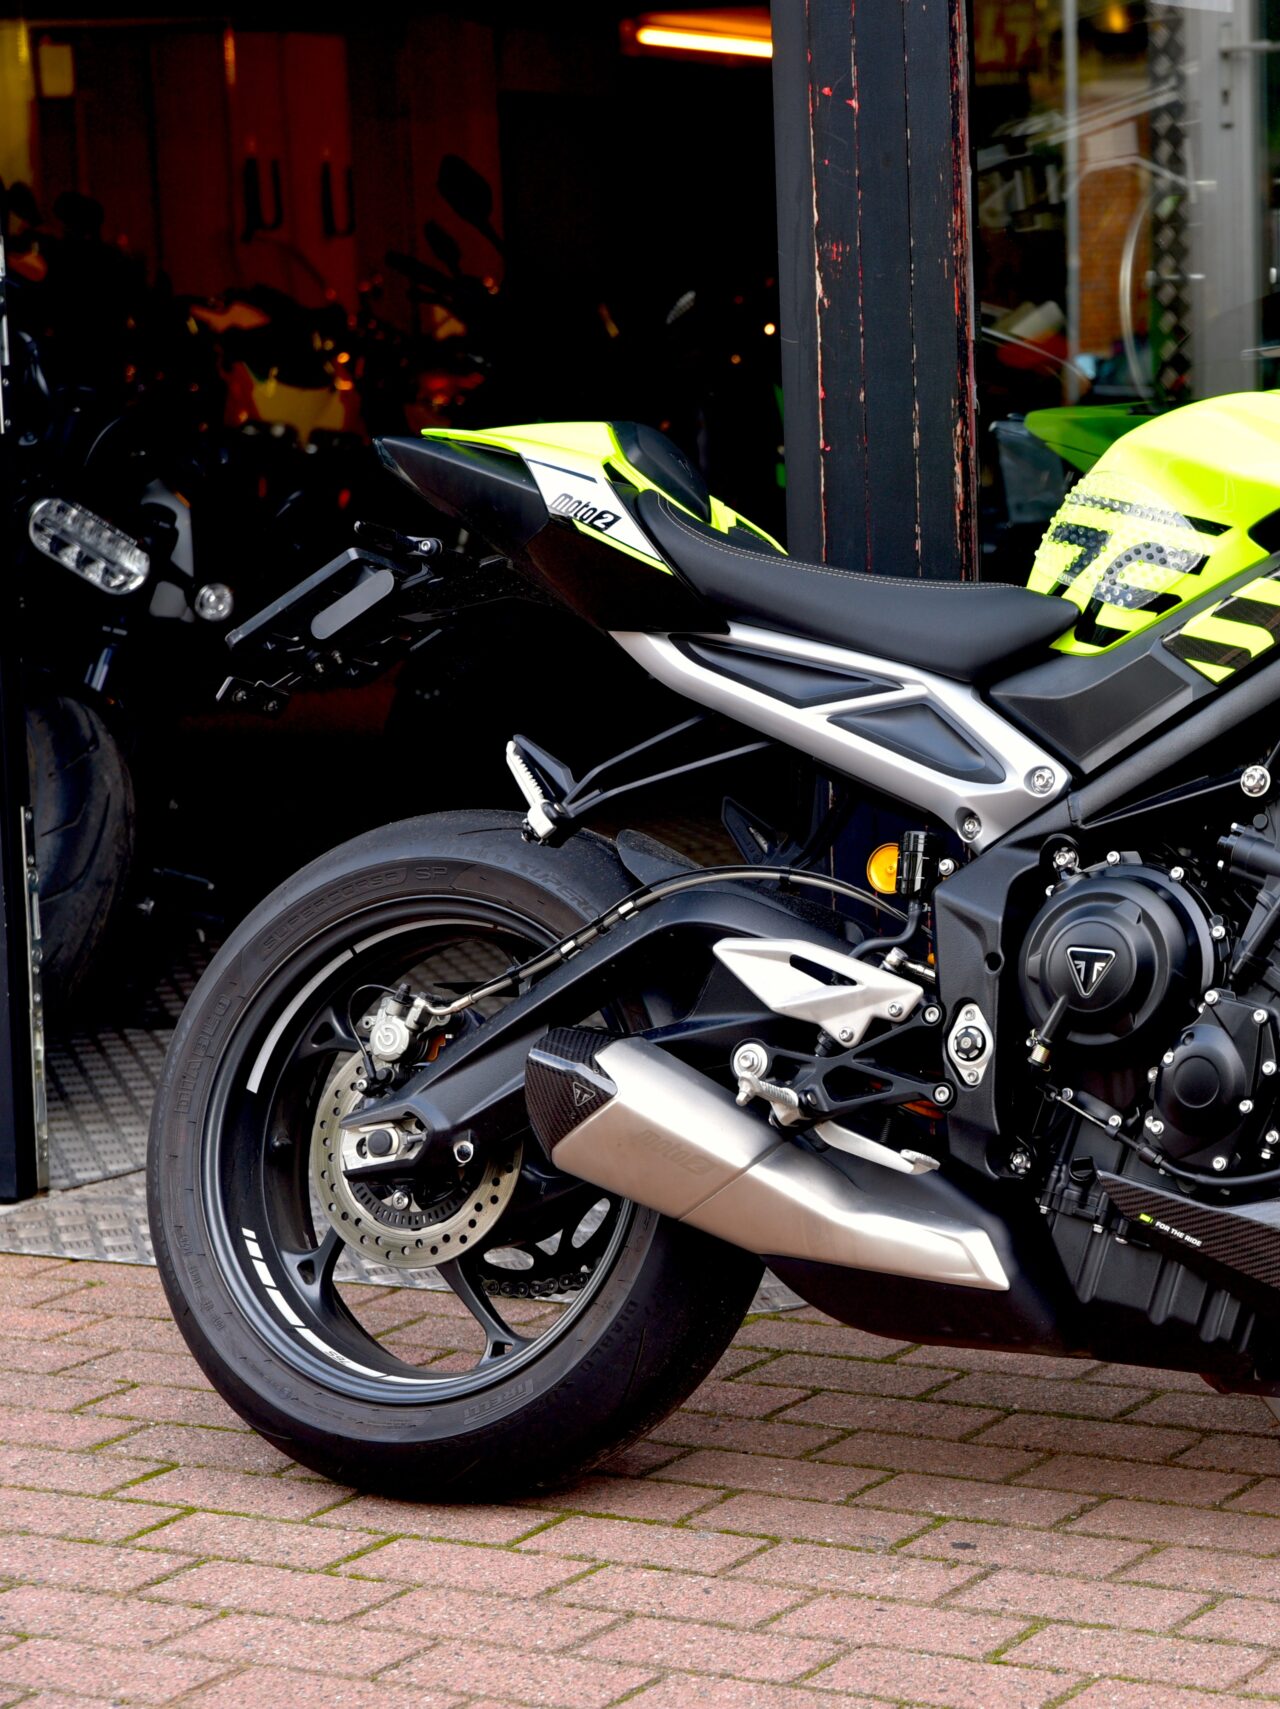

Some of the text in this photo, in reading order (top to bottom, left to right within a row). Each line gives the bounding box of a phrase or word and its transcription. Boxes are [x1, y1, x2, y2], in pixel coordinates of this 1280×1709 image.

[261, 865, 449, 951] SUPERCORSA SP
[174, 994, 233, 1115] DIABLO
[1155, 1221, 1202, 1247] FOR THE RIDE
[462, 1377, 535, 1426] PIRELLI
